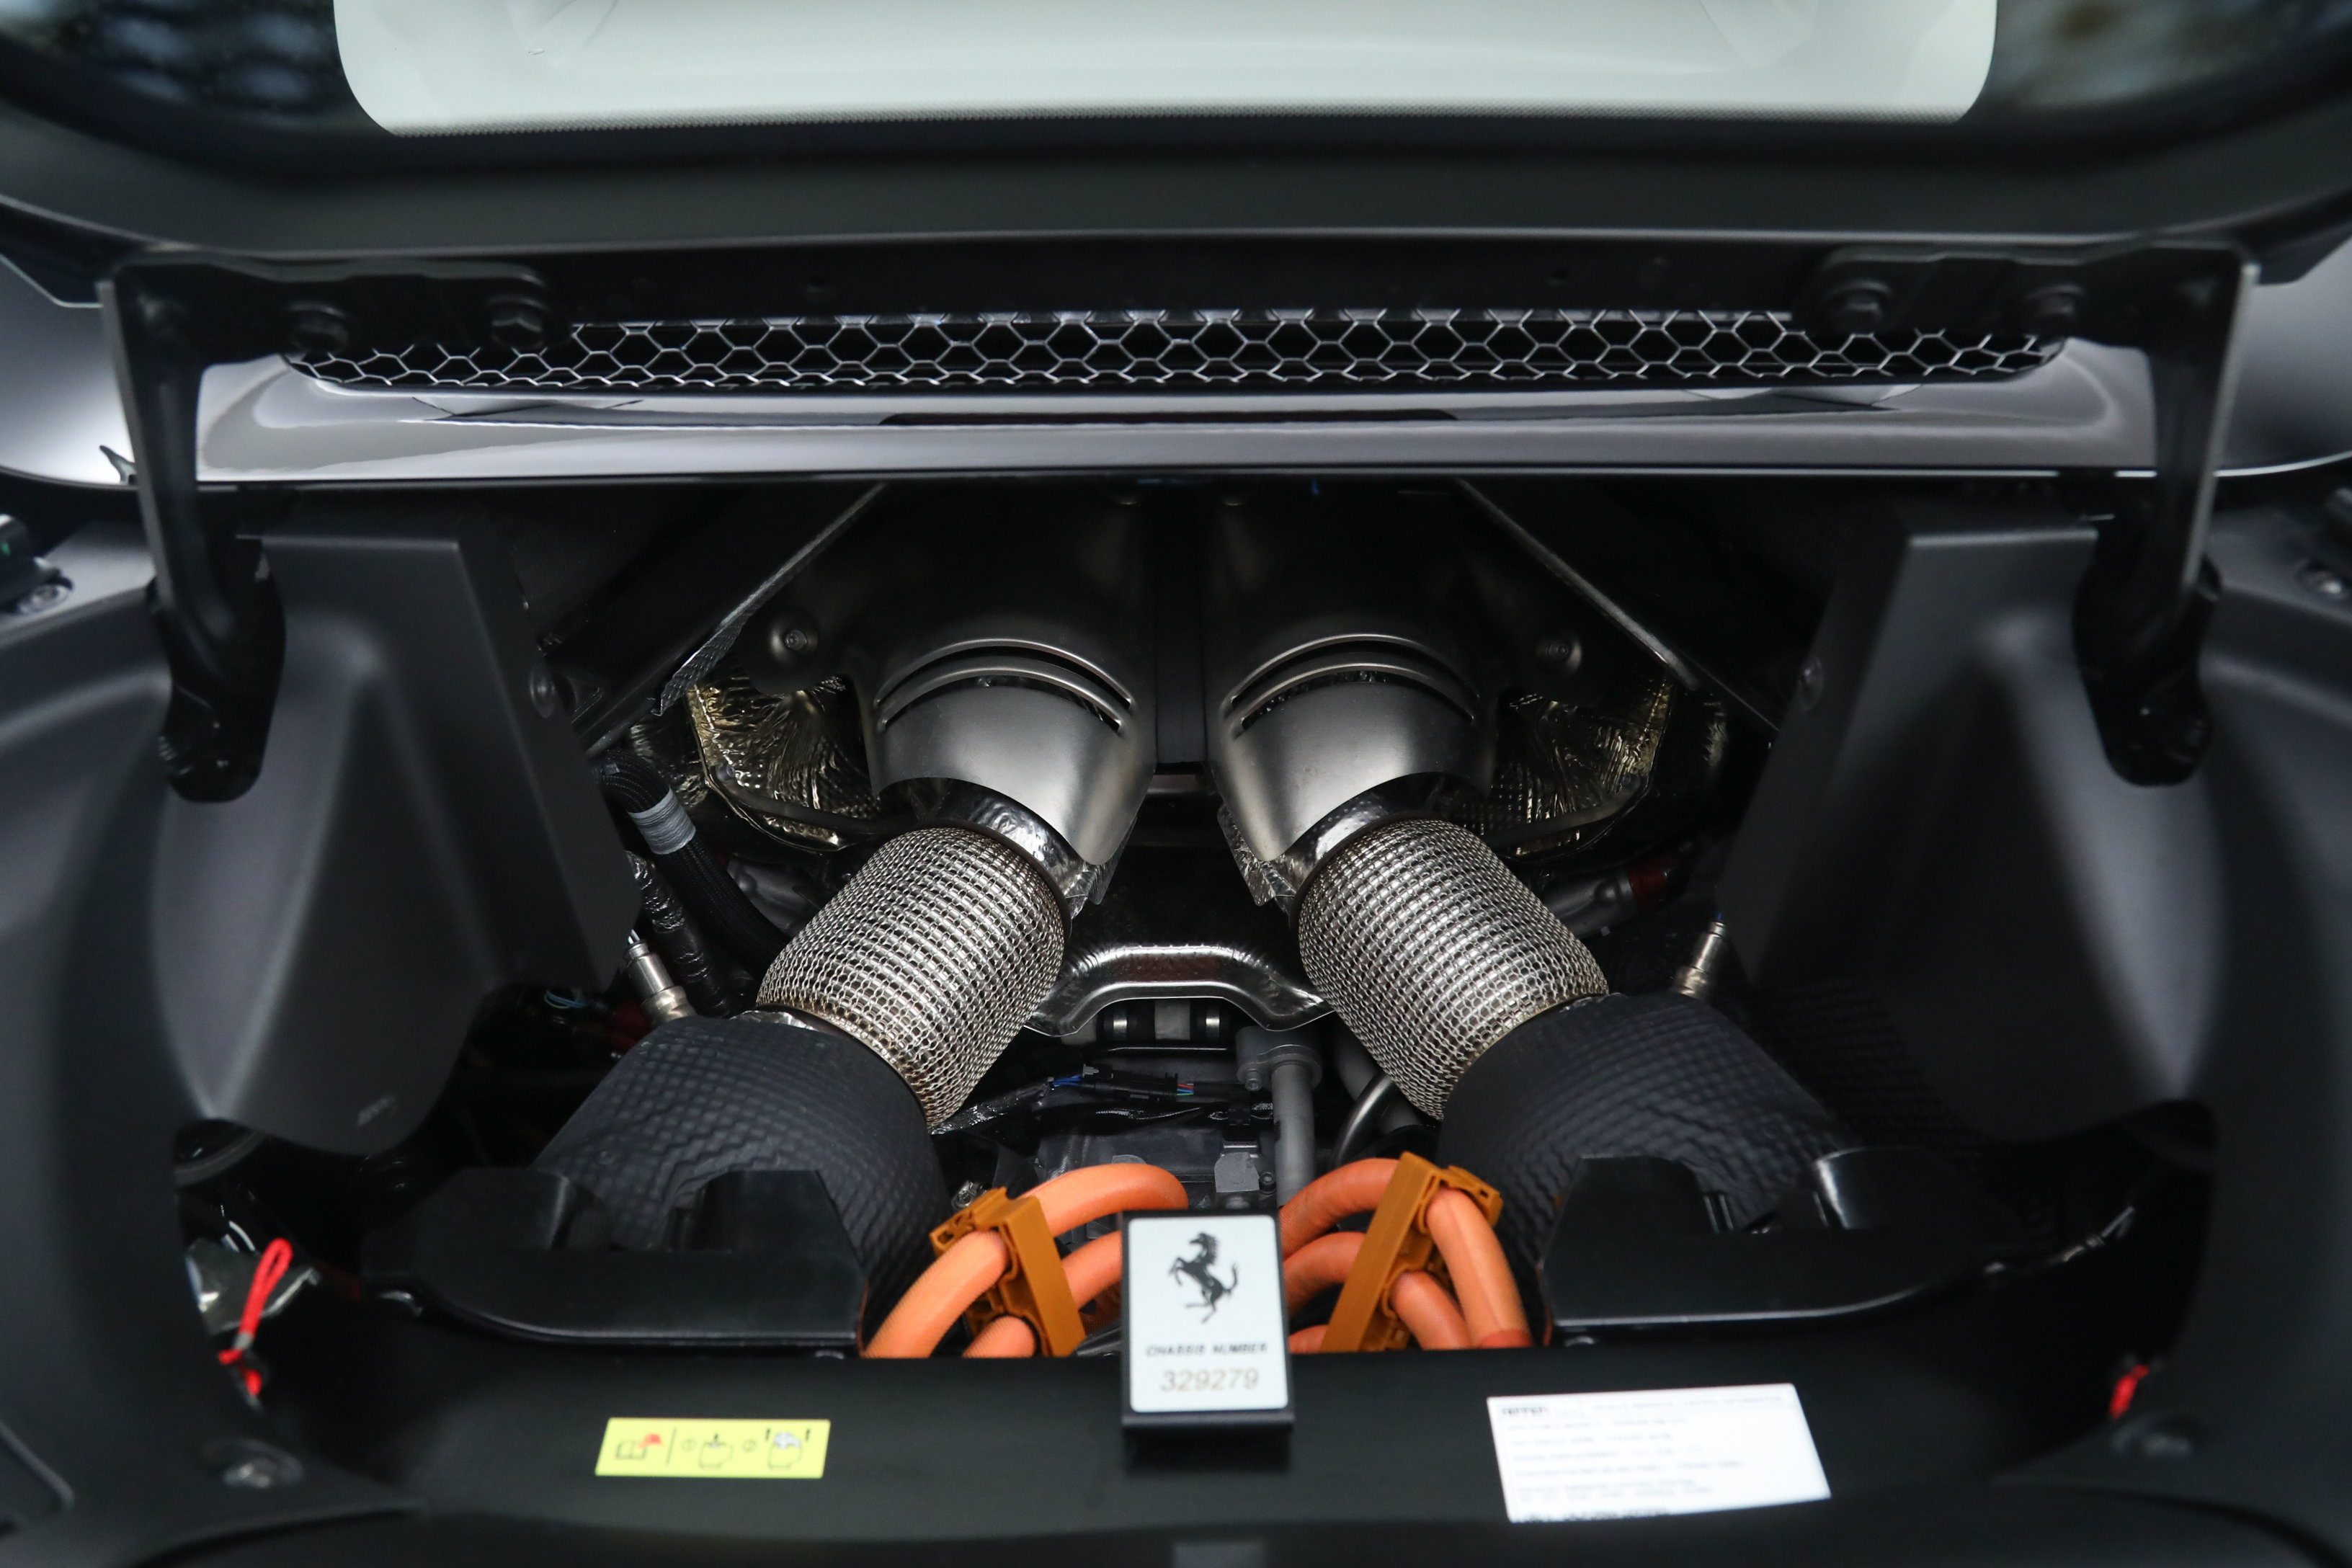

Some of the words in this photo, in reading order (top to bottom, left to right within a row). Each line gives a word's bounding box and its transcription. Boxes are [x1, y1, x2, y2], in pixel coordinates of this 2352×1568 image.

[1146, 1342, 1206, 1358] CHASSIS
[1212, 1340, 1268, 1355] NUMBER
[1161, 1368, 1260, 1392] 329279
